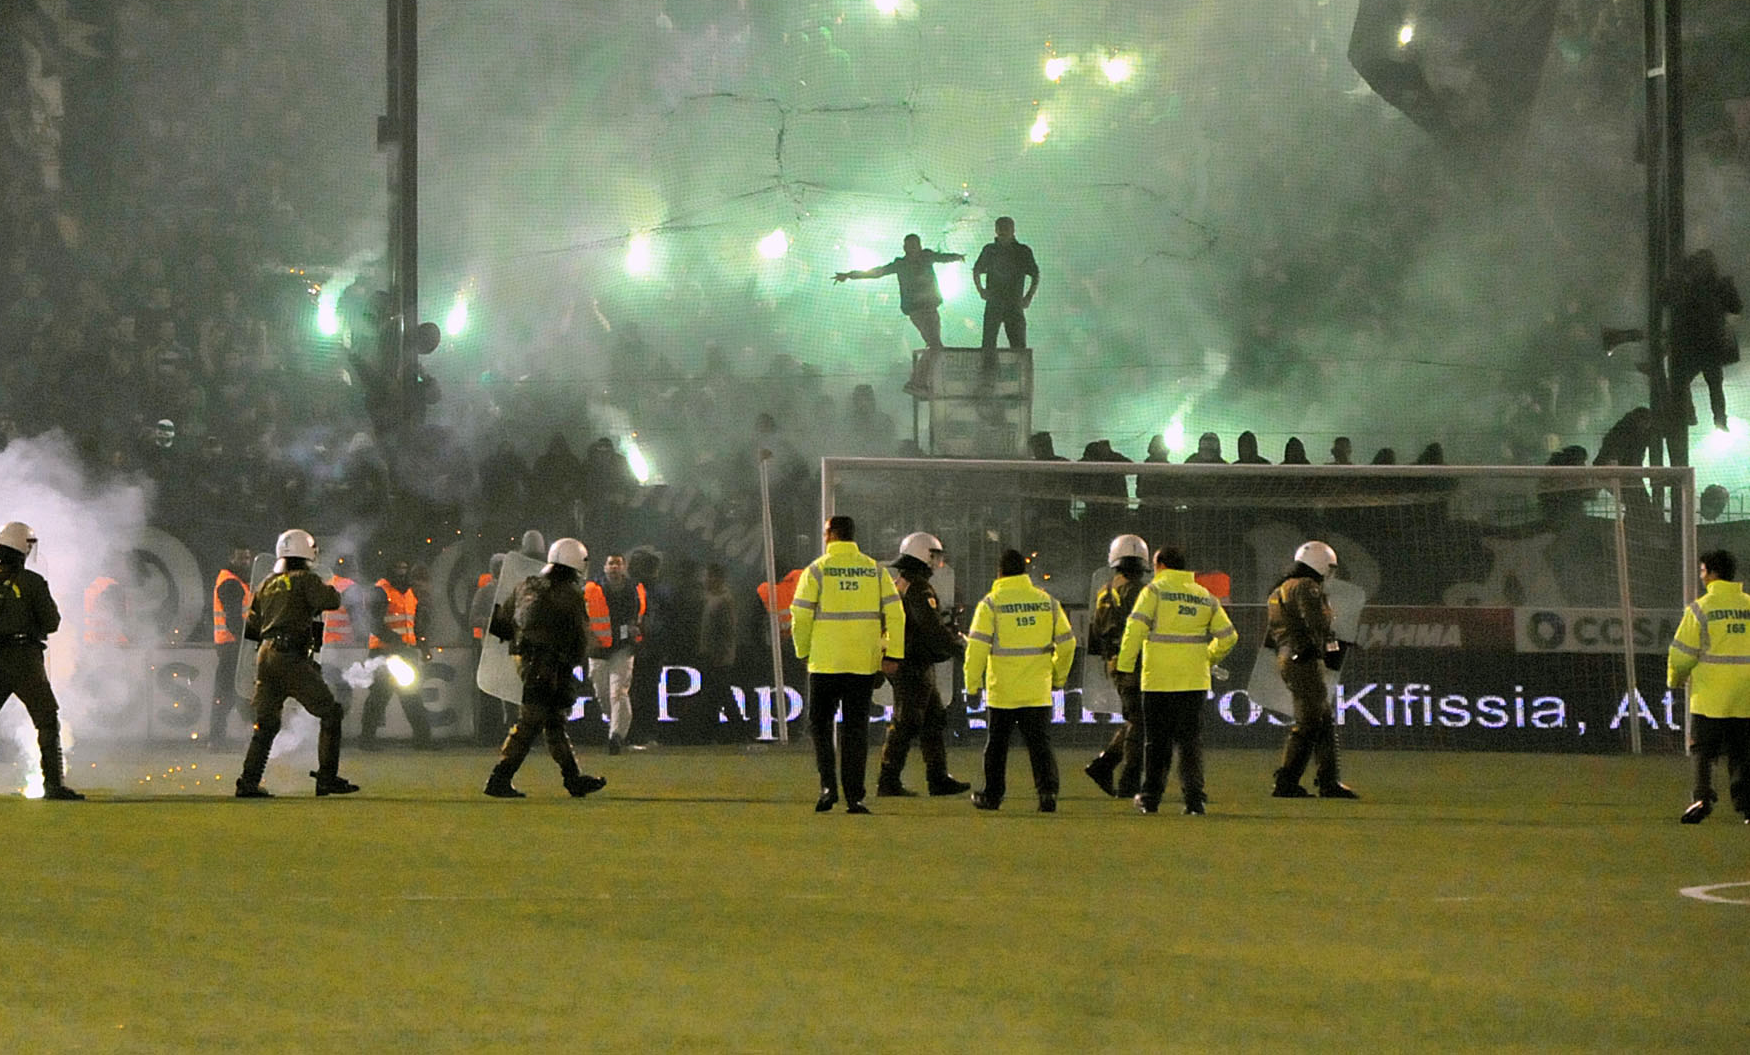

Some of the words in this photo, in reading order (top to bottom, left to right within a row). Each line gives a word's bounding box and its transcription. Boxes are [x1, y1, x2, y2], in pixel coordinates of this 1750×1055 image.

[830, 567, 877, 578] BRINKS
[839, 580, 859, 591] 125
[1170, 591, 1212, 606] BRINKS
[1006, 601, 1051, 614] BRINKS
[1015, 616, 1036, 627] 195
[1574, 616, 1676, 646] COSM
[1336, 682, 1587, 736] Kifissia,
[1609, 687, 1681, 730] At
